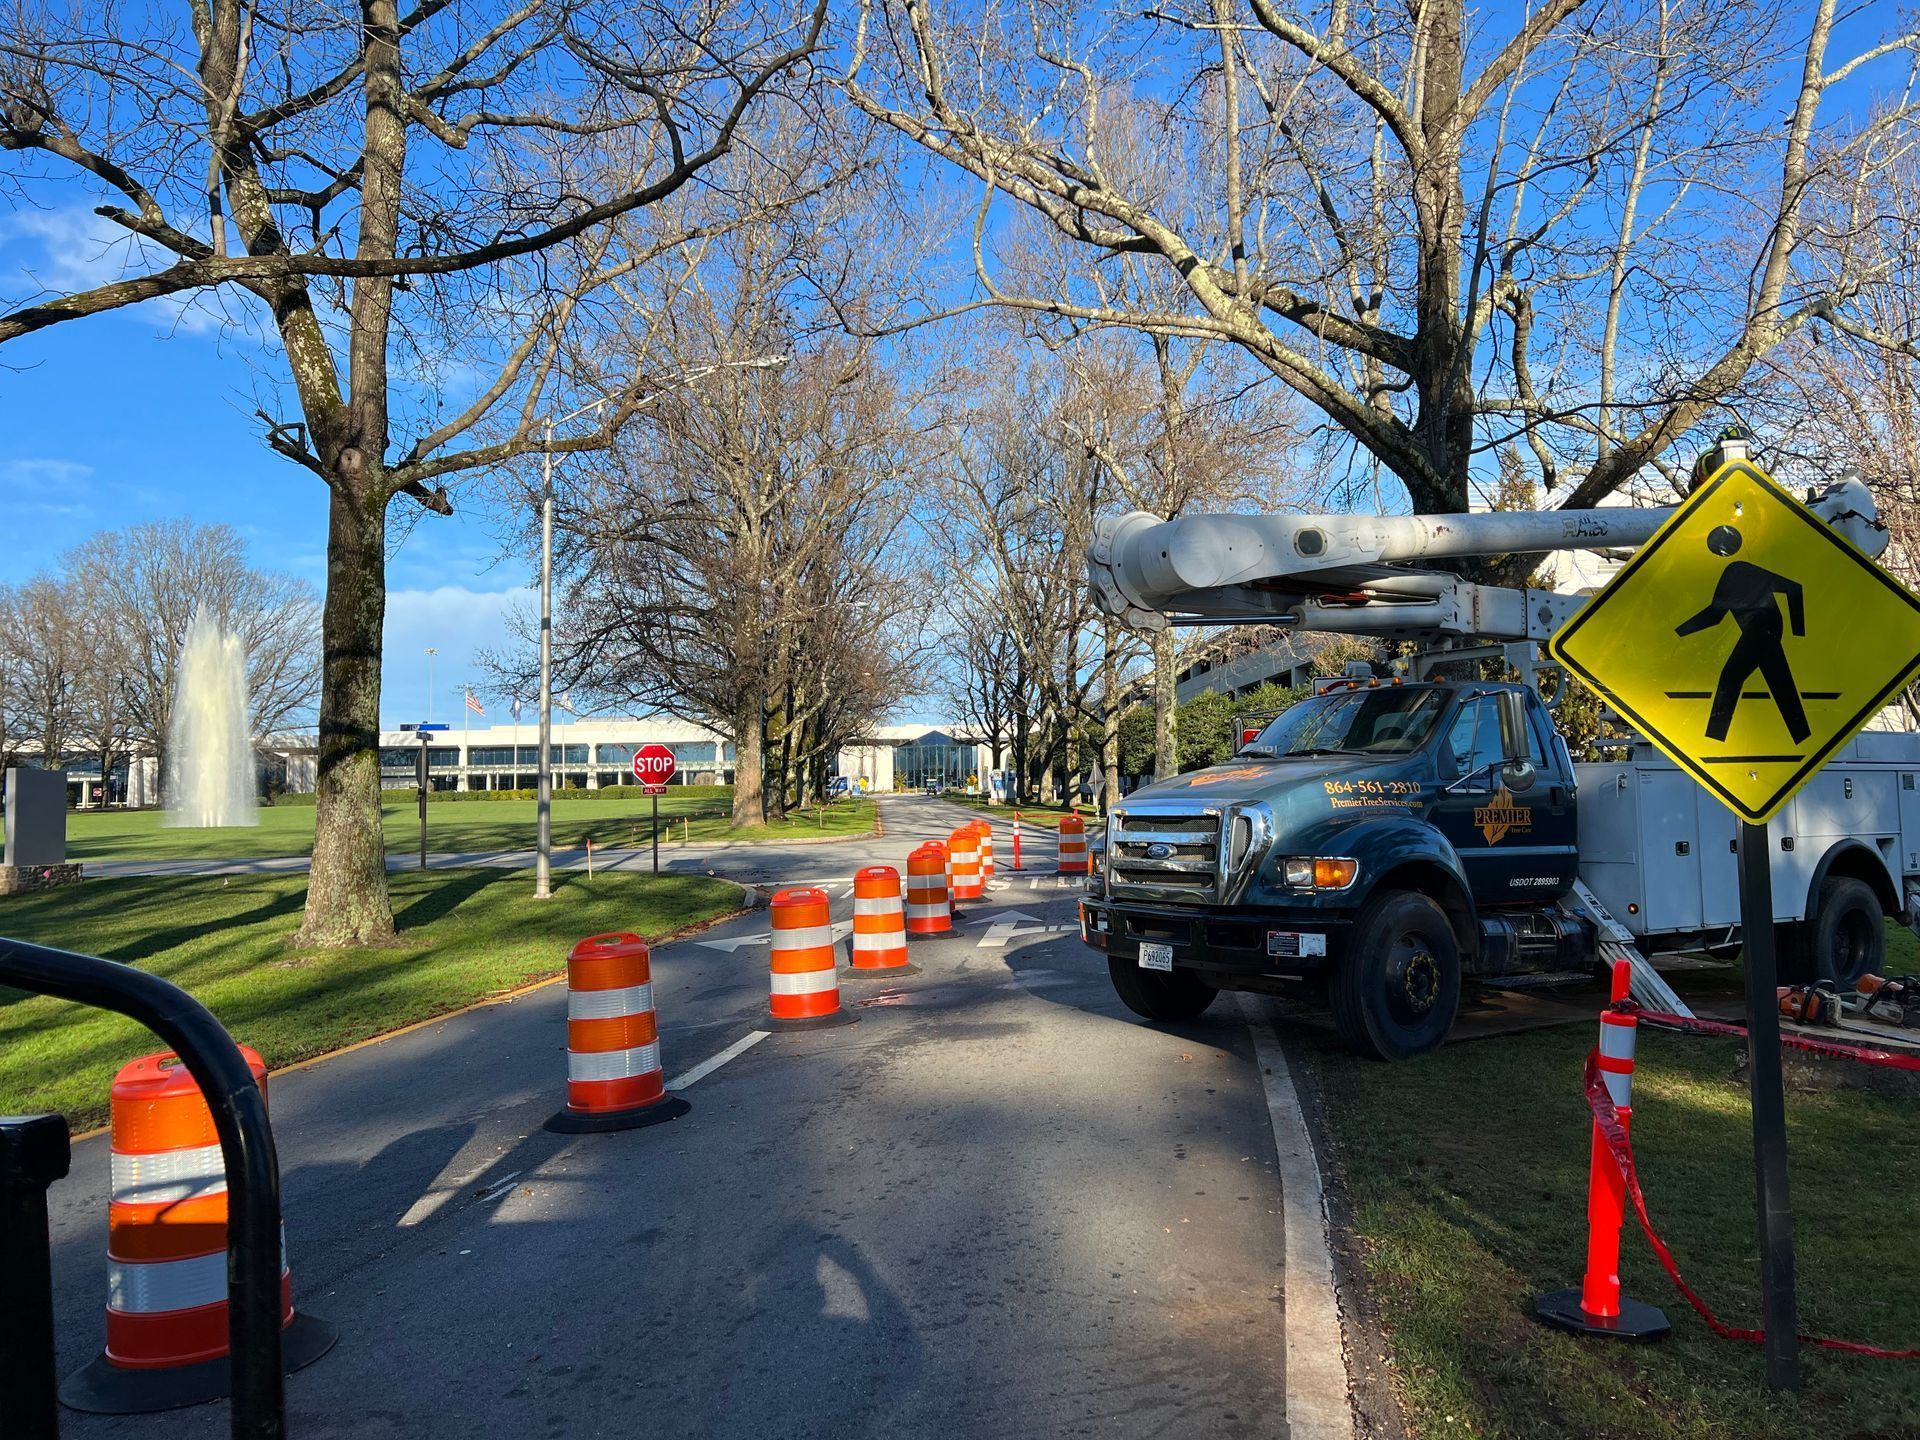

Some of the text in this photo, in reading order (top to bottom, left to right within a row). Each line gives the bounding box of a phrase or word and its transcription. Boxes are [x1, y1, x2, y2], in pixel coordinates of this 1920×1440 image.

[636, 757, 673, 773] STOP
[1324, 780, 1421, 795] 864-561-2810
[1330, 796, 1424, 809] PremierTreeServices.com
[1474, 809, 1531, 824] PREMIER
[1509, 878, 1534, 887] USDOT
